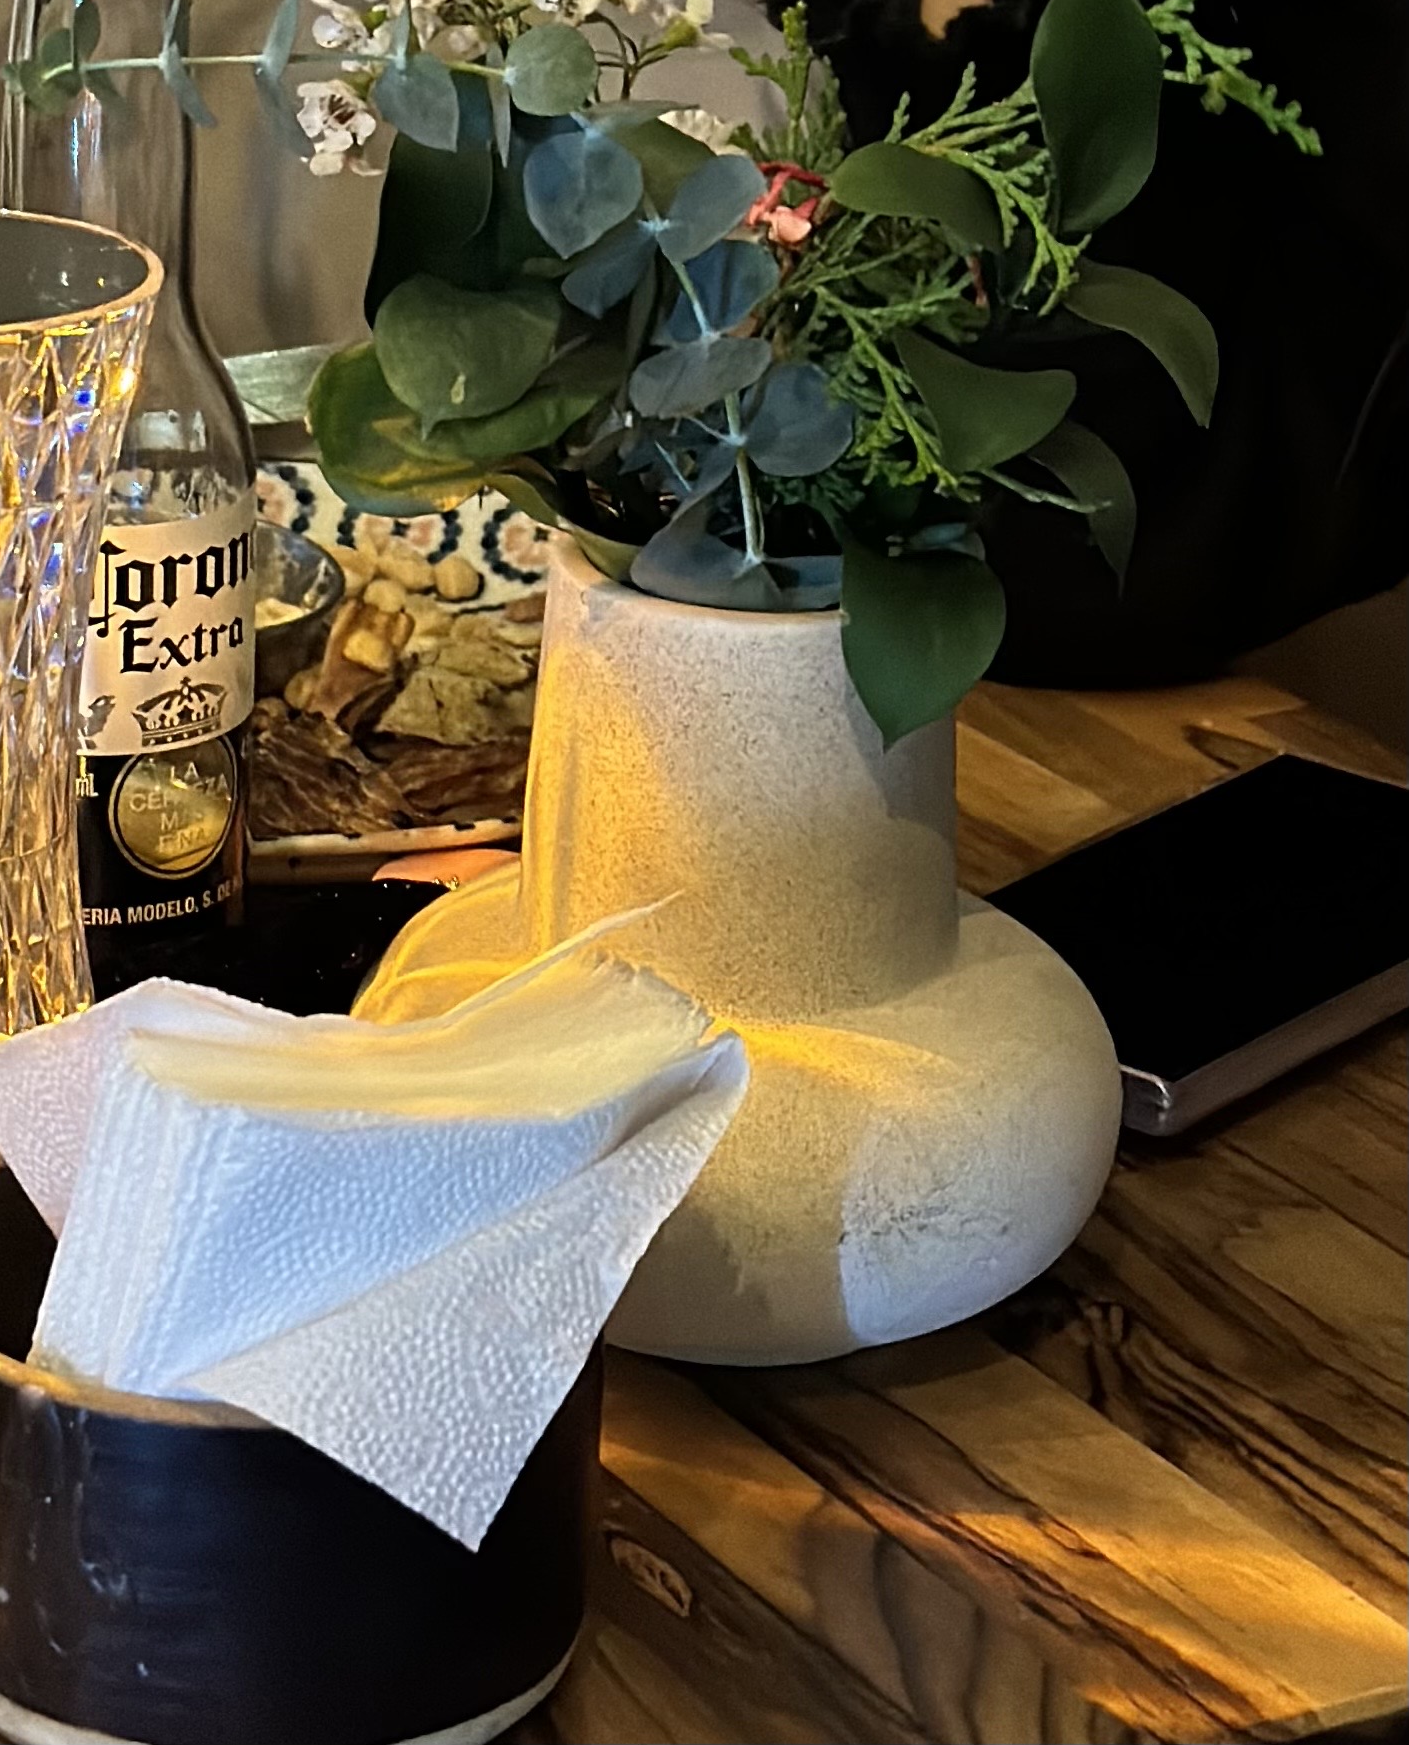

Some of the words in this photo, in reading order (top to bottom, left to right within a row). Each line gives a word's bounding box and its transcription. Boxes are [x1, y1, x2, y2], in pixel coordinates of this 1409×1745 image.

[118, 616, 243, 673] Extra
[83, 907, 123, 926] ERIA
[127, 896, 199, 925] MODELO,
